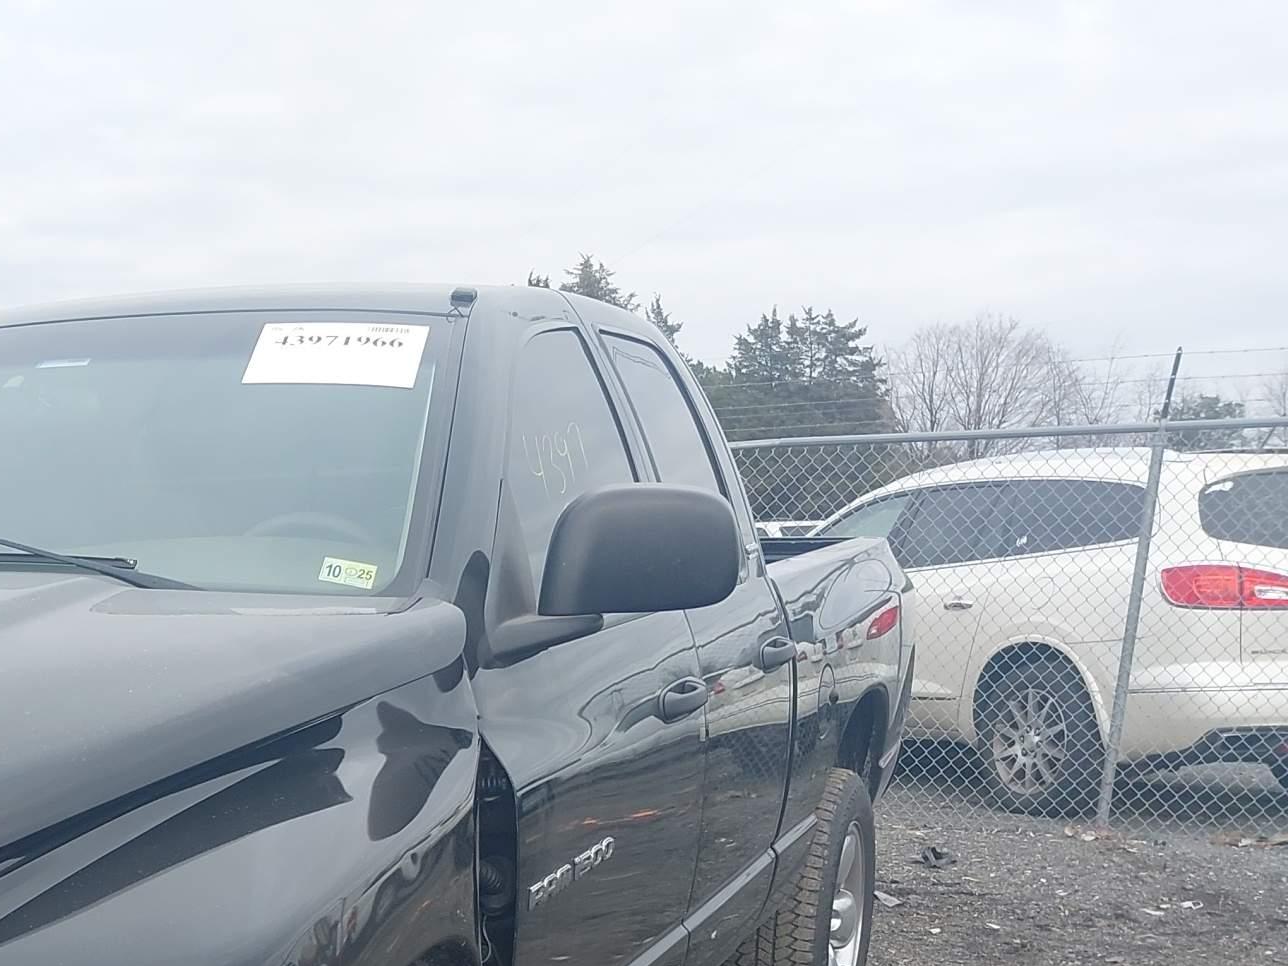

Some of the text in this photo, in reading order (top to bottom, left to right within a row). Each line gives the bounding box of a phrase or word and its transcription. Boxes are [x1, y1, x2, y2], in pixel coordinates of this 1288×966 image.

[274, 335, 404, 348] 43971966
[325, 563, 374, 581] 10 25
